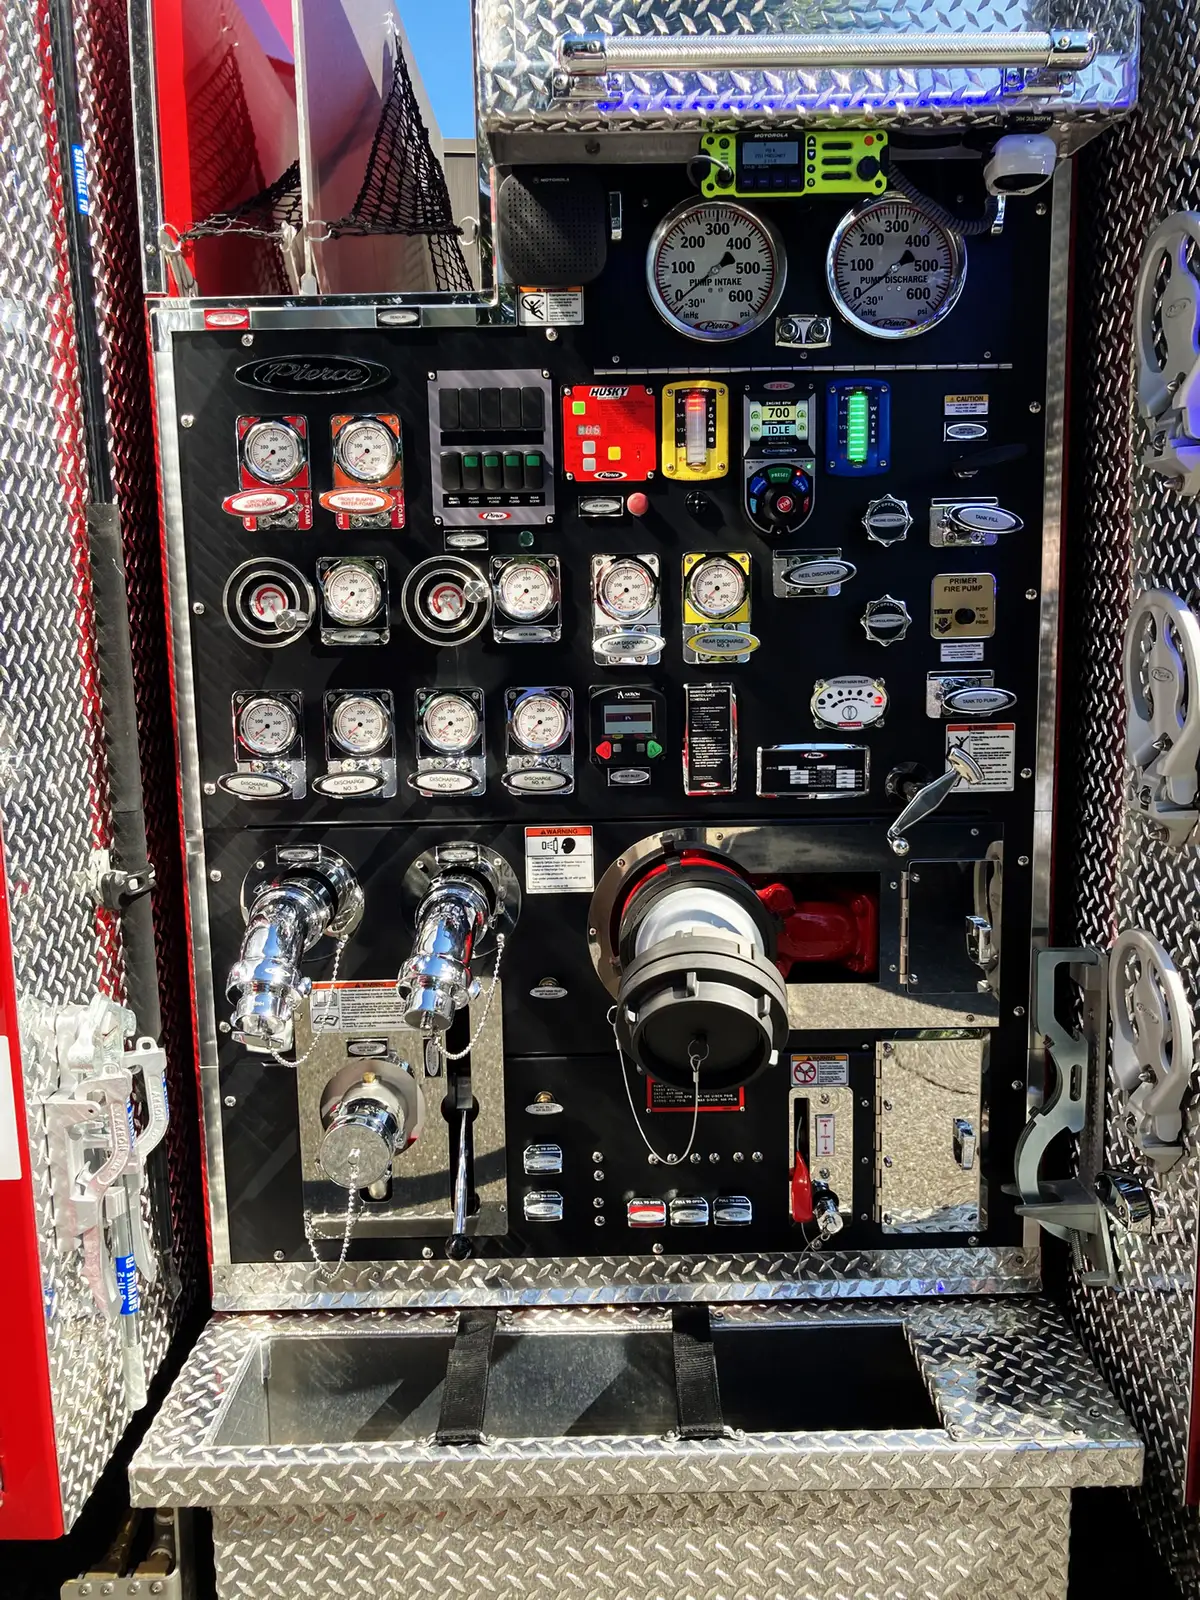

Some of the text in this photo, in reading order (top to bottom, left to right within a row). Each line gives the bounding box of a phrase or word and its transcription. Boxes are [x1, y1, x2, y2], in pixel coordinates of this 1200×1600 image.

[73, 147, 89, 213] SAYVILLE FD
[705, 222, 730, 236] 300
[884, 219, 910, 234] 300
[681, 235, 706, 249] 200
[726, 237, 751, 250] 400
[859, 232, 885, 247] 200
[904, 234, 930, 248] 400
[671, 260, 695, 274] 100
[736, 261, 760, 275] 500
[849, 258, 874, 272] 100
[913, 258, 939, 272] 500
[689, 278, 743, 287] PUMP INTAKE
[860, 274, 929, 285] PUMP DISCHARGE
[674, 288, 684, 302] 0
[728, 289, 753, 303] 600
[853, 286, 863, 300] 0
[906, 287, 932, 301] 600
[684, 298, 706, 308] -30"
[862, 296, 884, 306] -30"
[683, 310, 700, 320] inHg
[740, 311, 751, 319] psi
[861, 308, 877, 317] inHg
[917, 308, 928, 316] psi
[704, 321, 731, 331] Pierce
[262, 362, 364, 384] Pierce
[590, 386, 628, 397] HUSKY
[768, 407, 790, 419] 700
[768, 425, 790, 435] IDLE
[869, 405, 878, 443] WATER
[304, 503, 312, 526] FOAM
[396, 502, 404, 525] FOAM
[975, 513, 999, 523] TANK FILL
[798, 569, 841, 580] REEL DISCHARGE
[949, 577, 978, 585] PRIMER
[607, 640, 621, 648] REAR
[240, 780, 270, 788] DISCHARGE
[125, 1254, 138, 1312] SAYVILLE FD
